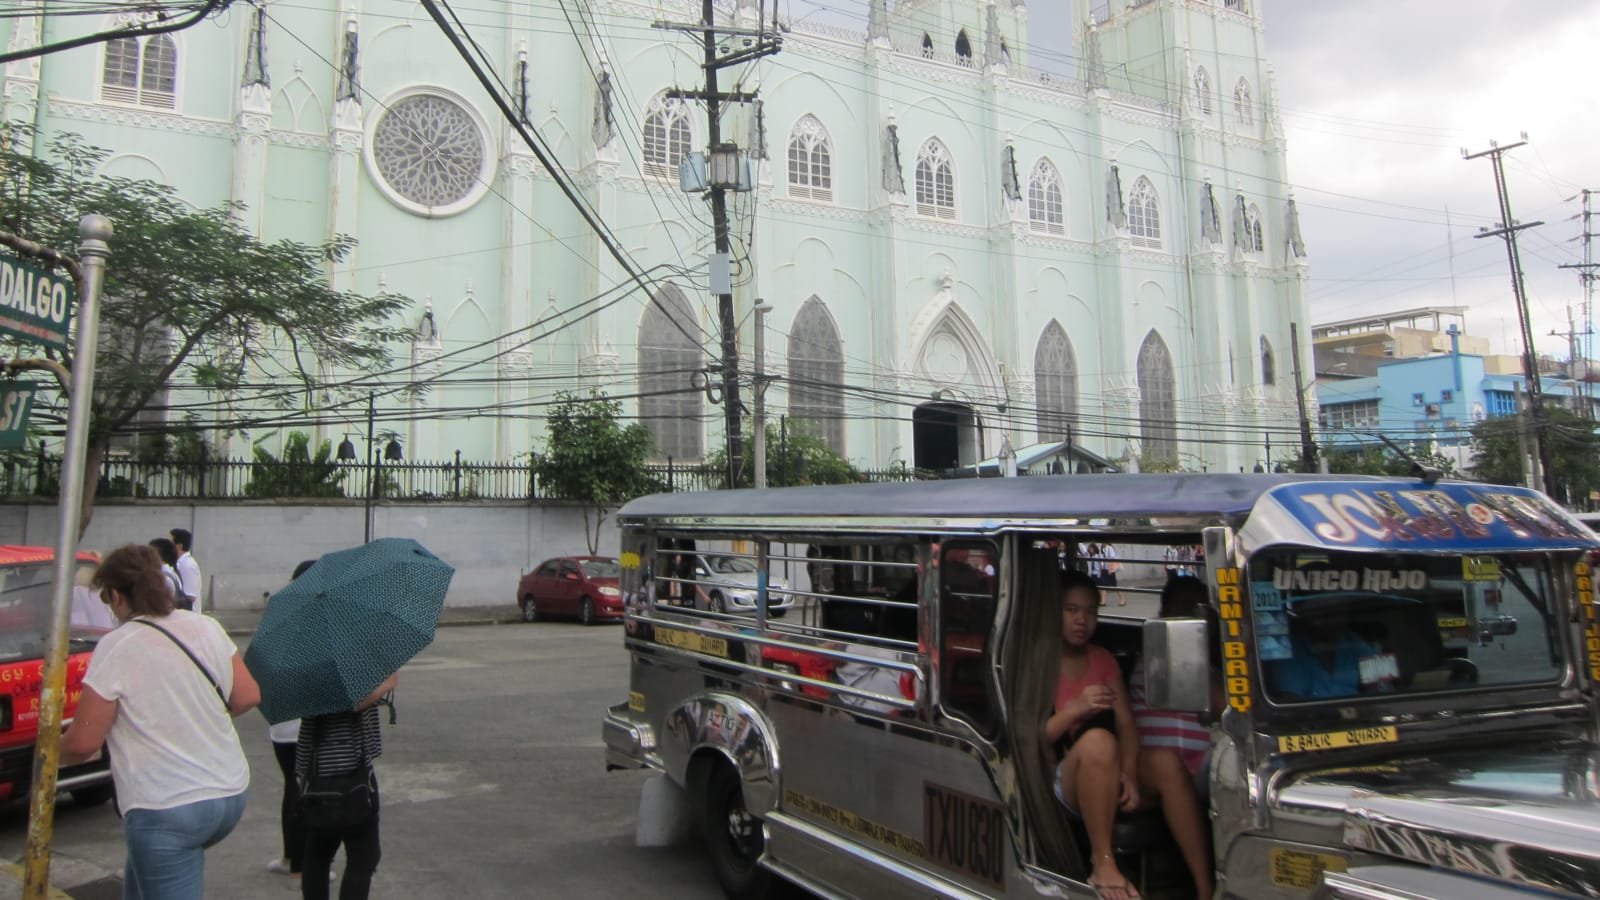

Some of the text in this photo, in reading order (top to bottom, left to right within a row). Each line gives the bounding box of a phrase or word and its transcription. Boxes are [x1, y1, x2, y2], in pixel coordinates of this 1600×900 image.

[0, 260, 66, 323] DALGO
[1274, 566, 1427, 592] UNICO HIJO
[1224, 641, 1251, 712] BABY
